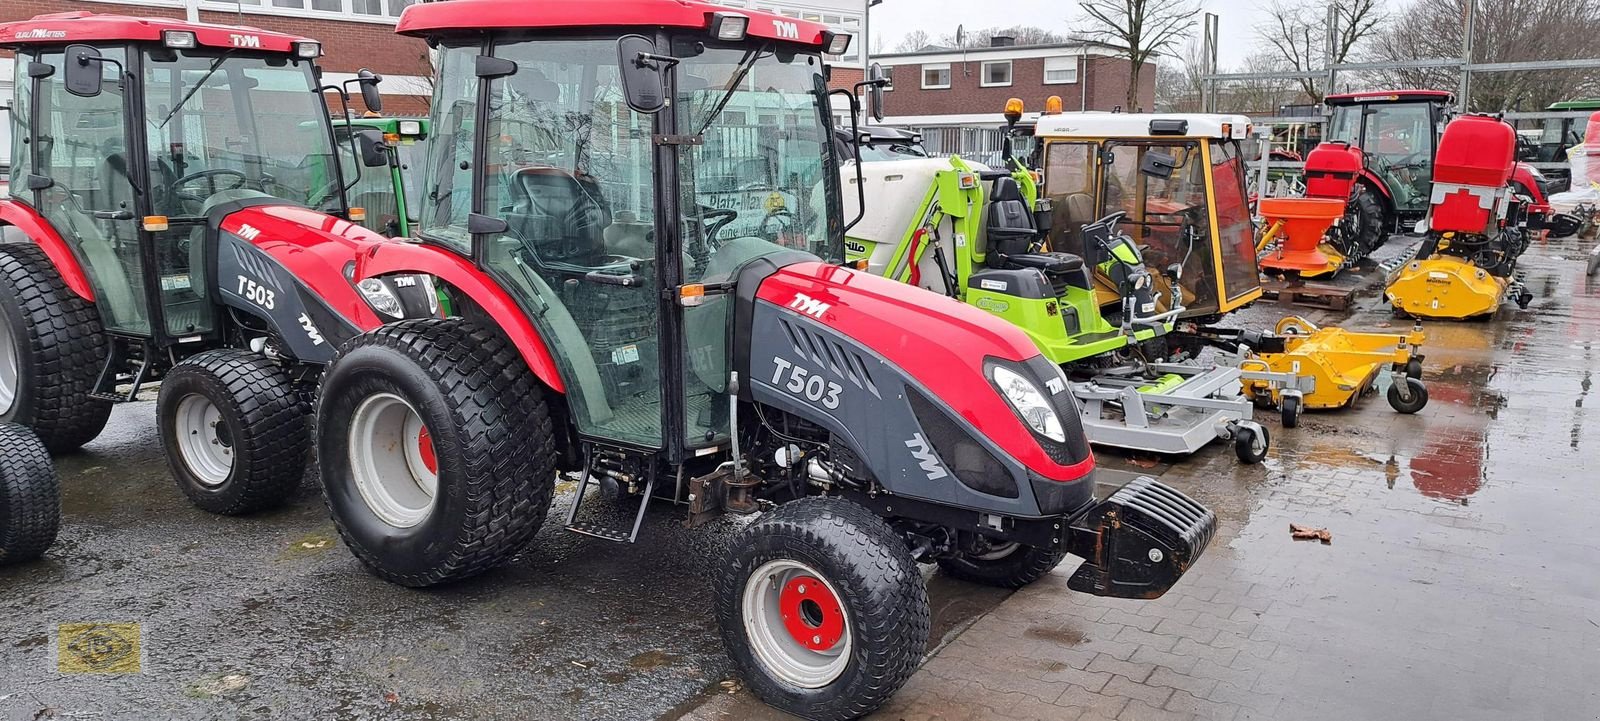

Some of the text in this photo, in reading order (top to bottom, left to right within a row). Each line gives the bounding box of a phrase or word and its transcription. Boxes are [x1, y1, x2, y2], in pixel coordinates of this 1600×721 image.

[772, 19, 799, 39] TYM
[230, 34, 260, 48] TYM
[237, 223, 261, 240] TYM
[237, 275, 275, 310] T503
[394, 276, 416, 288] TYM
[790, 293, 832, 318] TYM
[298, 312, 325, 346] TYM
[771, 356, 844, 410] T503
[1045, 376, 1065, 396] TYM
[904, 432, 948, 481] TYM
